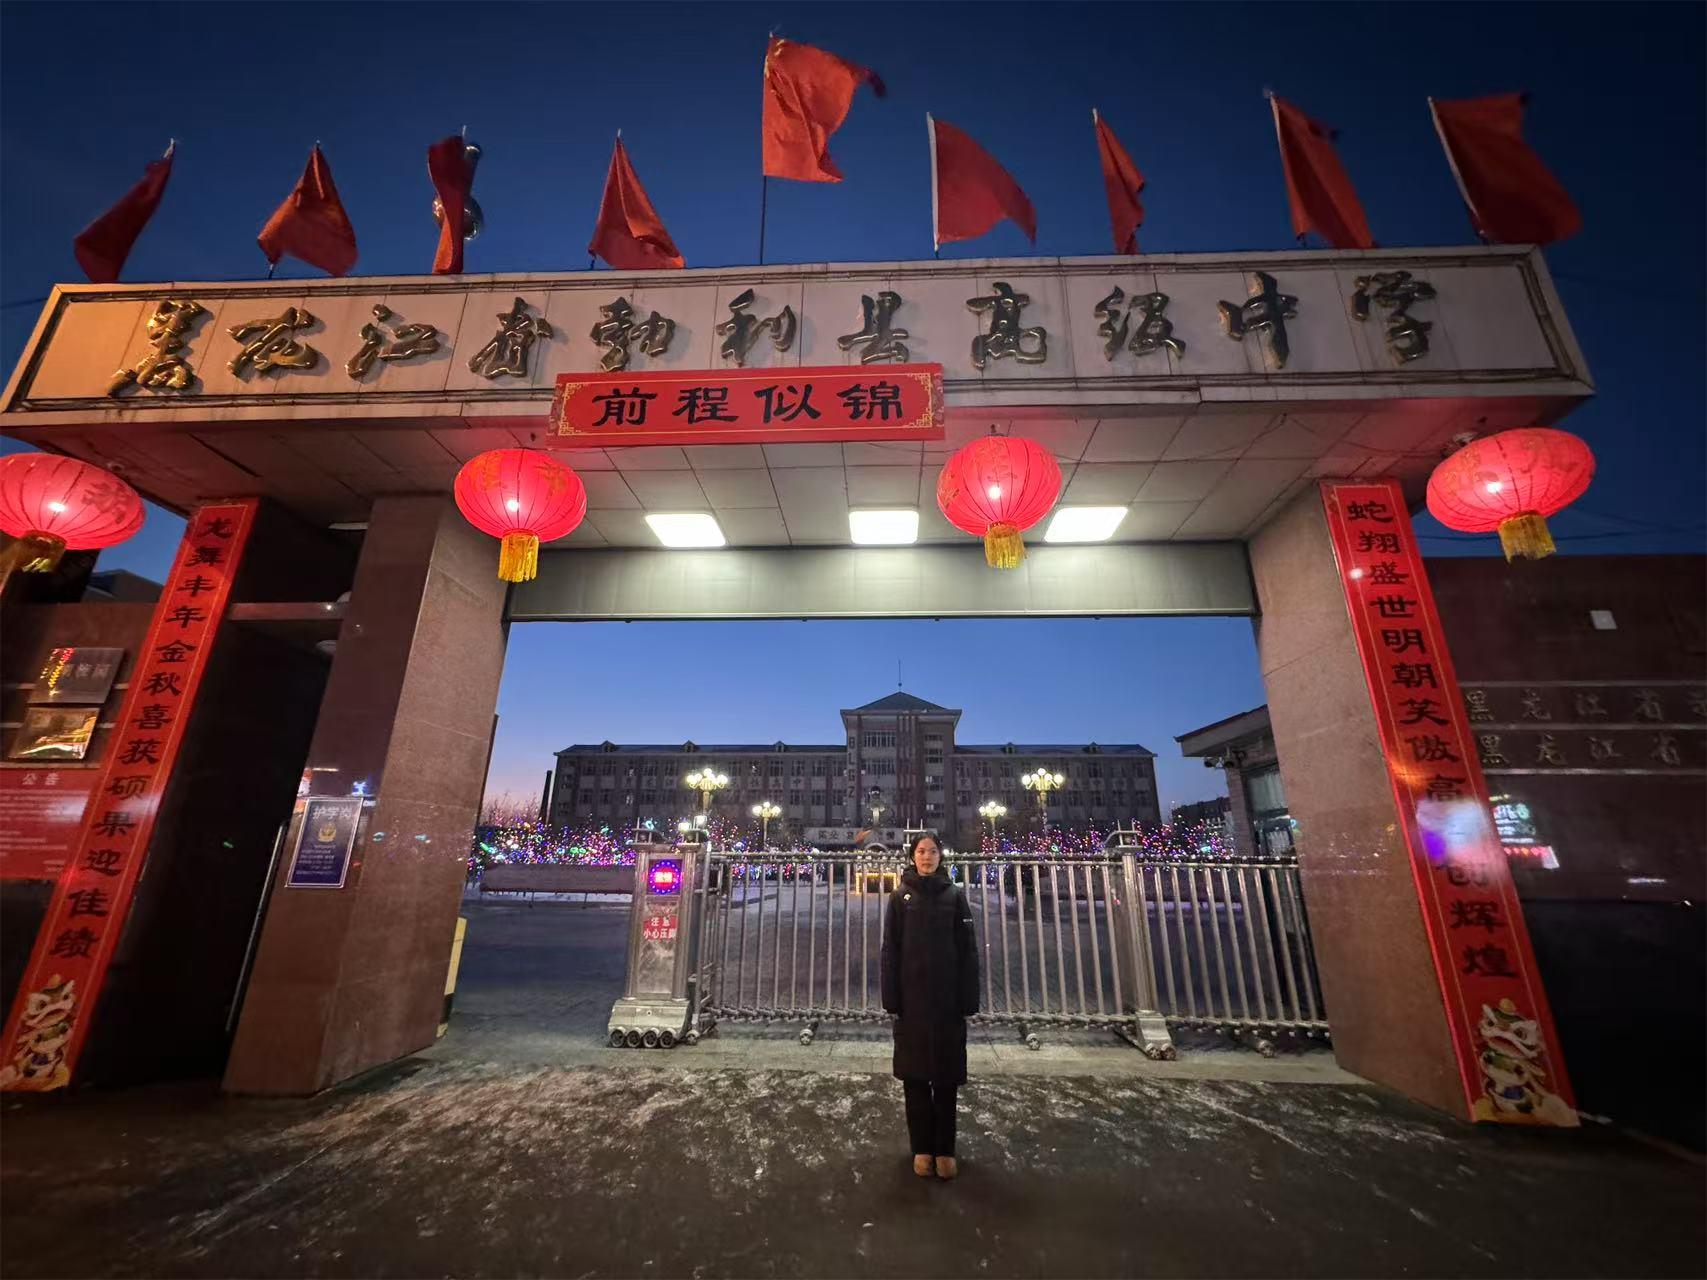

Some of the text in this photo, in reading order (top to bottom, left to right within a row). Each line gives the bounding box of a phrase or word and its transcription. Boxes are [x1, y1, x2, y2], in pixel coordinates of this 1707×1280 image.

[591, 380, 904, 427] 前程似锦
[22, 773, 62, 786] 公告
[50, 517, 234, 958] 龙舞丰年金秋喜获硕果迎佳绩
[1346, 500, 1520, 978] 蛇翔盛世明朝笑傲高创辉煌
